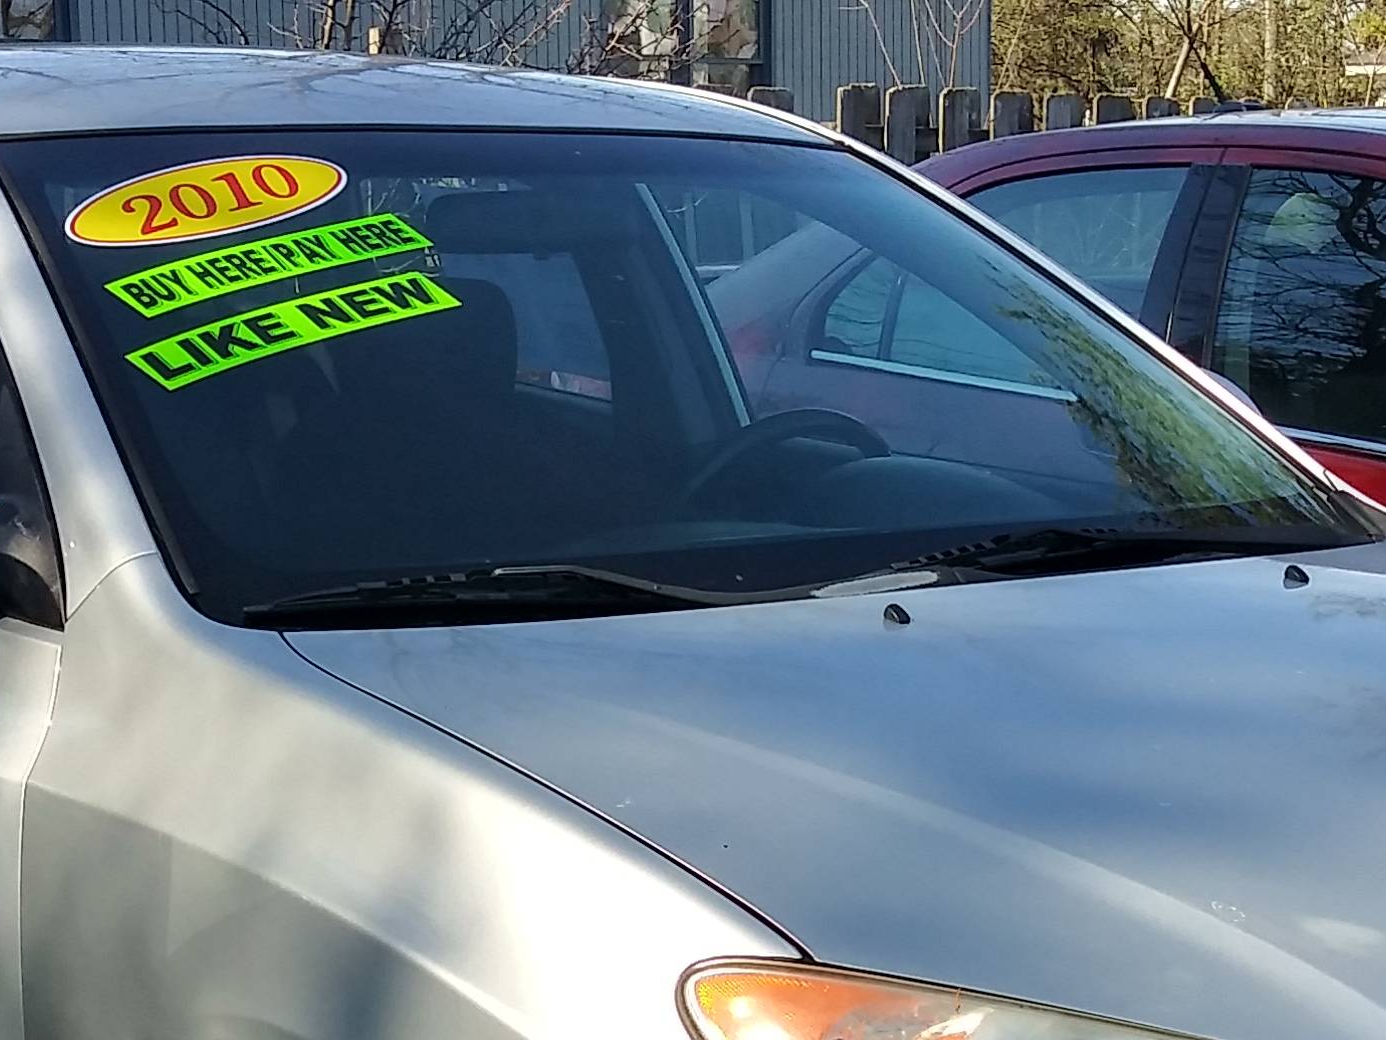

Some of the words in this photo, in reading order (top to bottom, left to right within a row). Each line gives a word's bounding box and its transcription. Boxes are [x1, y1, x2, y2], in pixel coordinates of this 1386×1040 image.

[121, 163, 300, 236] 2010
[120, 269, 197, 310] BUY
[185, 234, 337, 290] HERE/PAY
[328, 219, 421, 254] HERE
[139, 312, 303, 381] LIKE
[296, 278, 440, 330] NEW
